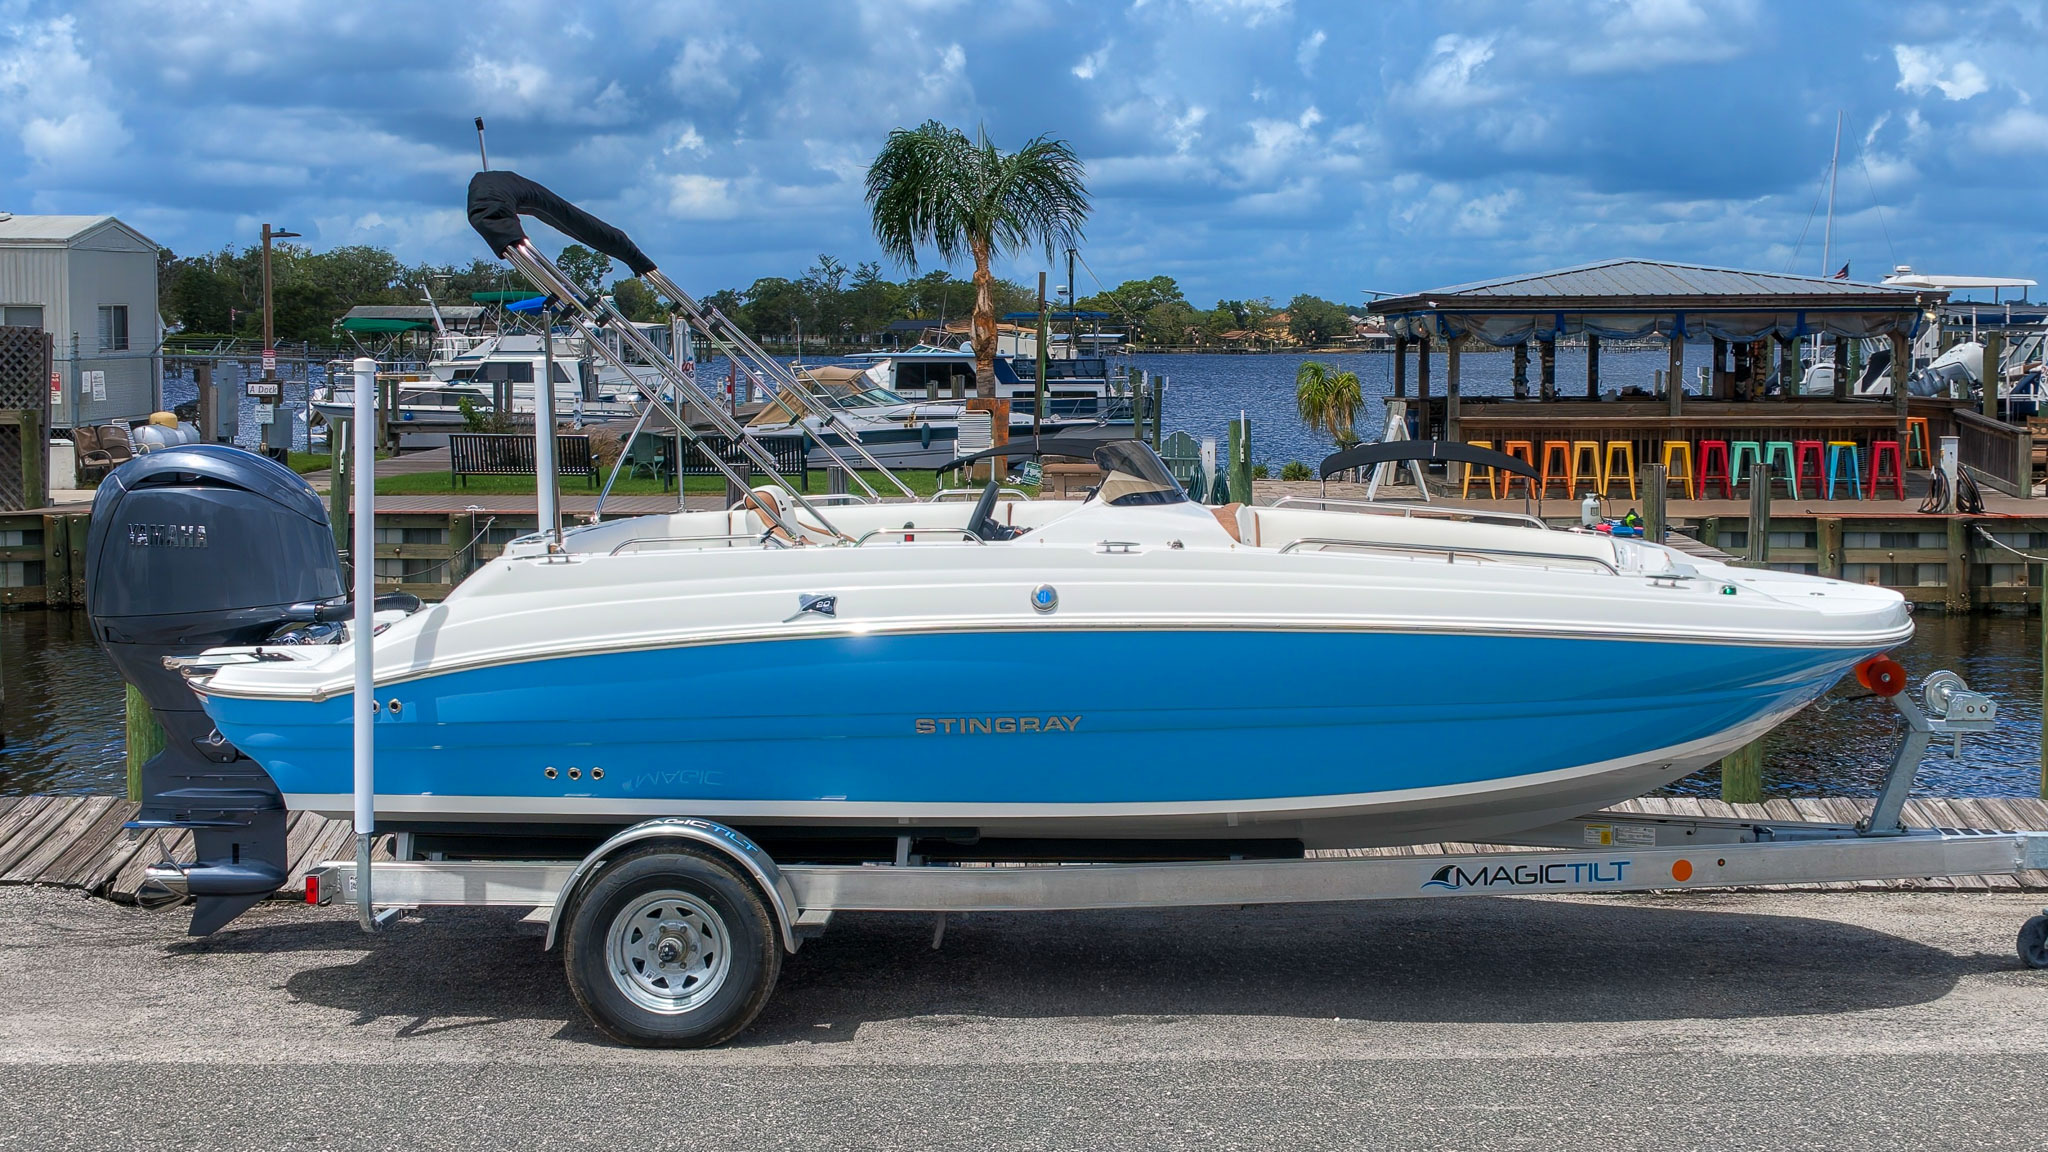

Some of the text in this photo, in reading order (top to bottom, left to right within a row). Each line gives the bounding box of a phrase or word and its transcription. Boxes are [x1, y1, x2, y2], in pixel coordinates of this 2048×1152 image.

[249, 385, 278, 394] A Dock
[128, 523, 208, 547] YAMAHA
[915, 715, 1083, 735] STINGRAY
[1455, 861, 1631, 886] MAGICTILT
